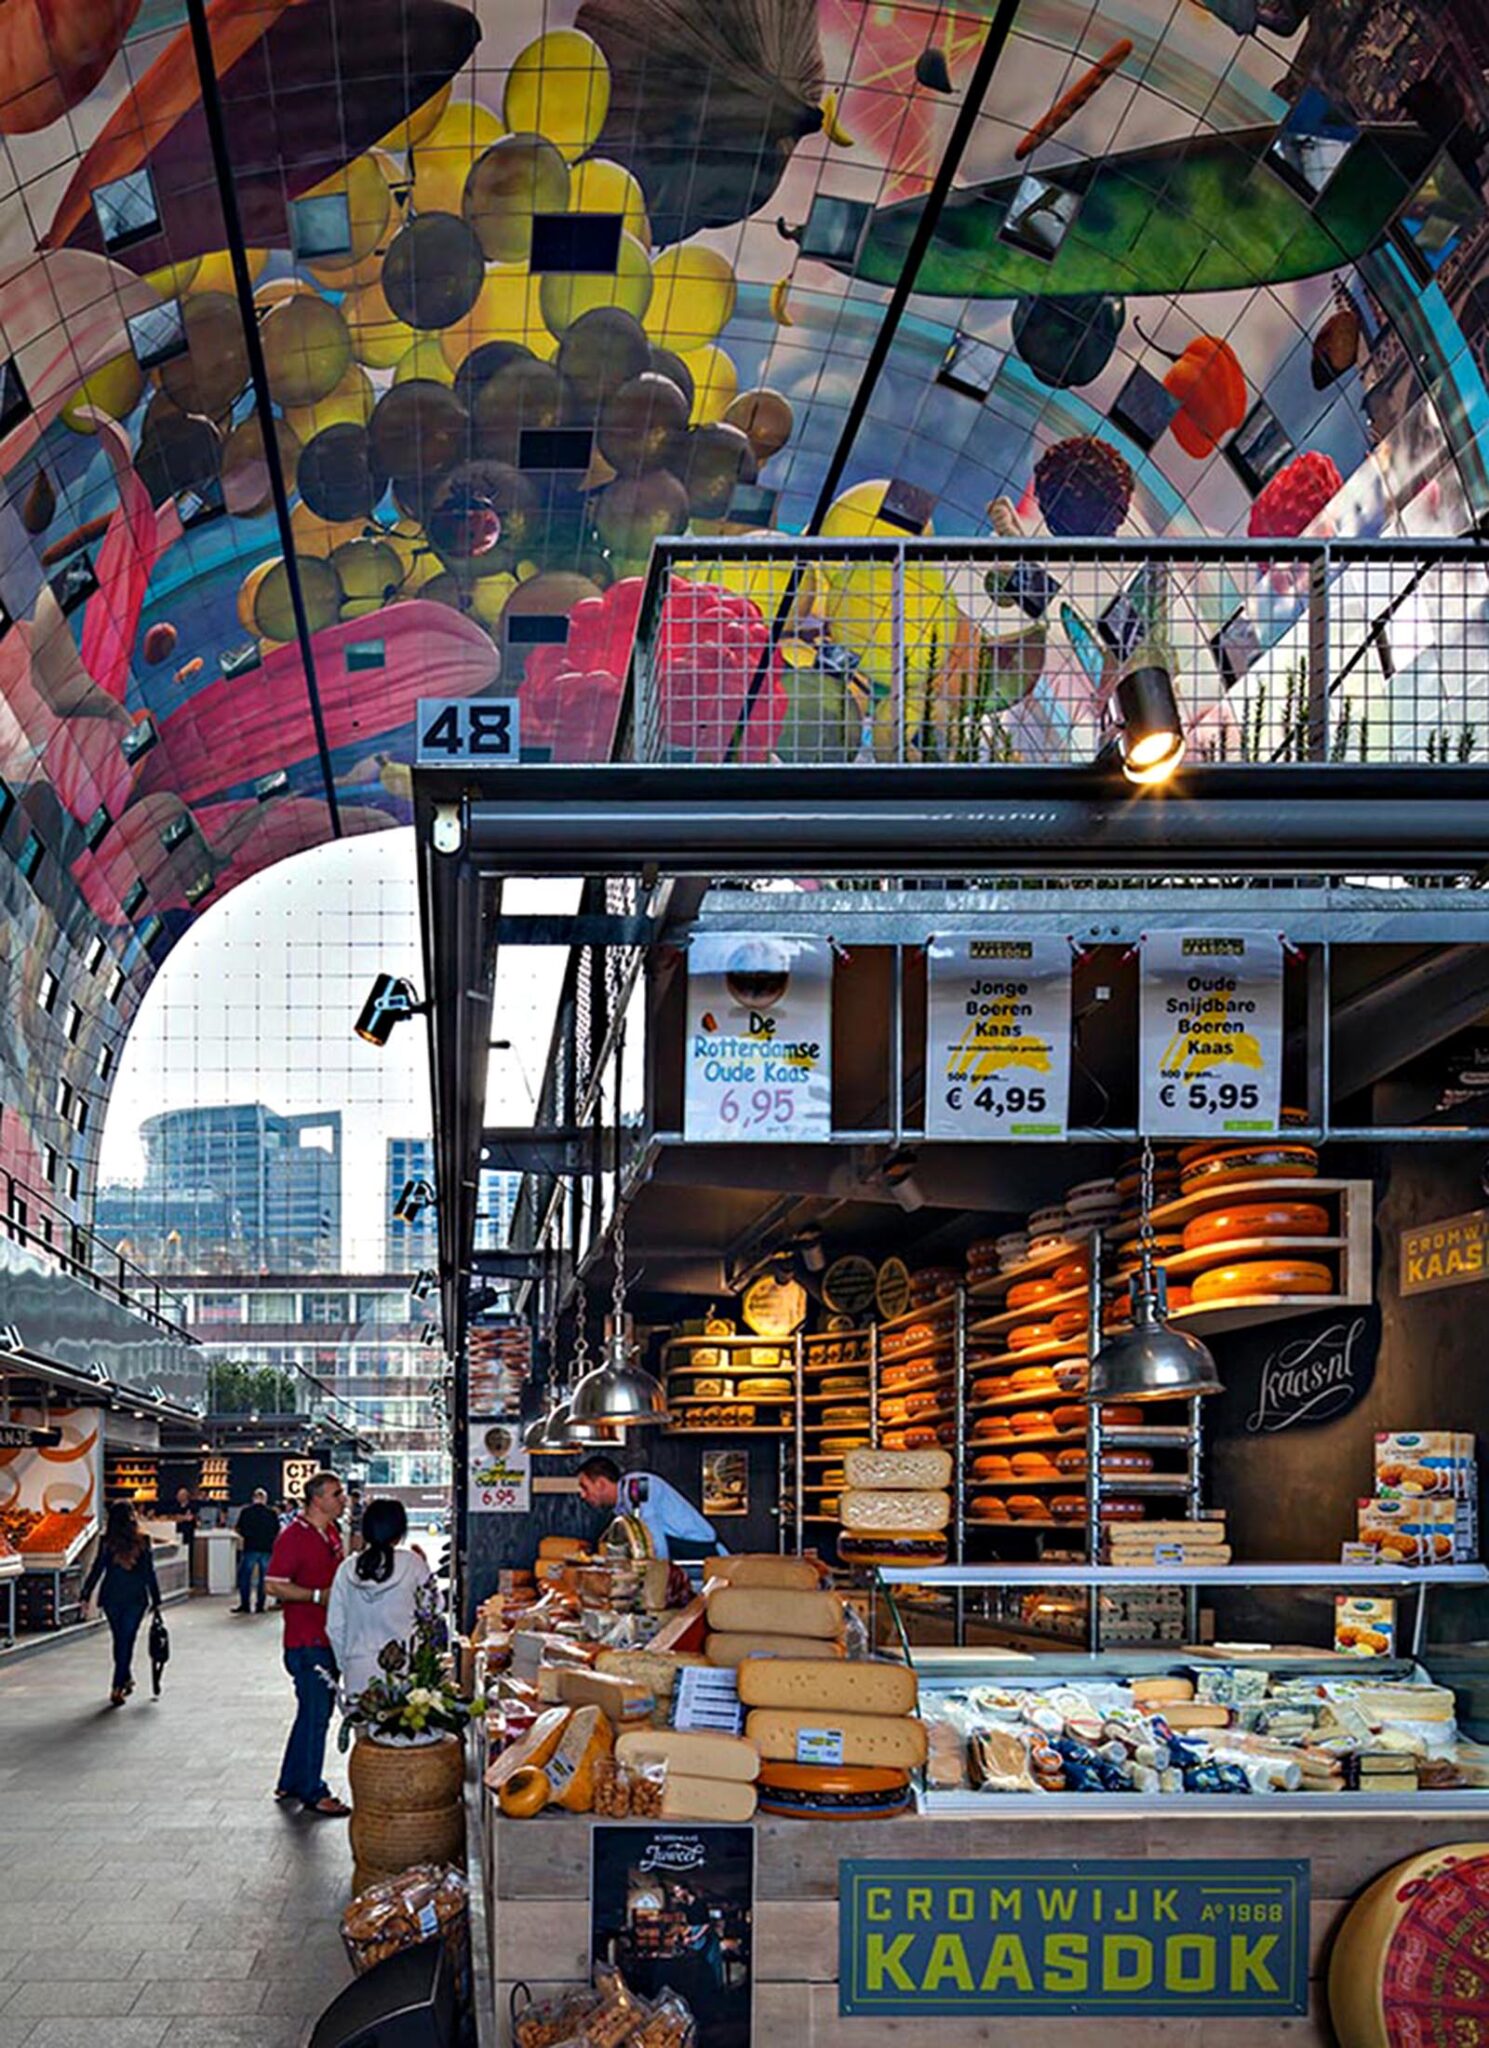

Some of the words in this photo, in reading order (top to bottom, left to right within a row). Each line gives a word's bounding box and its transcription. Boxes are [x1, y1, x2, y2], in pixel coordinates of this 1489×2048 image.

[422, 705, 511, 754] 48
[970, 980, 1028, 997] Jonge
[1187, 976, 1236, 991] Oude
[966, 1001, 1032, 1016] Boeren
[1166, 998, 1256, 1015] Snijdbare
[749, 1012, 775, 1034] De
[976, 1022, 1022, 1037] Kaas
[1178, 1019, 1244, 1034] Boeren
[694, 1035, 820, 1059] Rotterdamse
[1187, 1041, 1234, 1055] Kaas
[704, 1061, 755, 1082] Oude
[764, 1061, 810, 1083] Kaas
[720, 1089, 795, 1128] 6,95
[946, 1087, 962, 1110] €
[974, 1086, 1046, 1117] 4,95
[1160, 1085, 1176, 1107] €
[1189, 1084, 1259, 1114] 5,95
[1408, 1240, 1489, 1283] KAAS
[865, 1887, 1179, 1922] CROMWIJK
[1228, 1904, 1283, 1922] 1968
[865, 1933, 1280, 1992] KAASDOK
